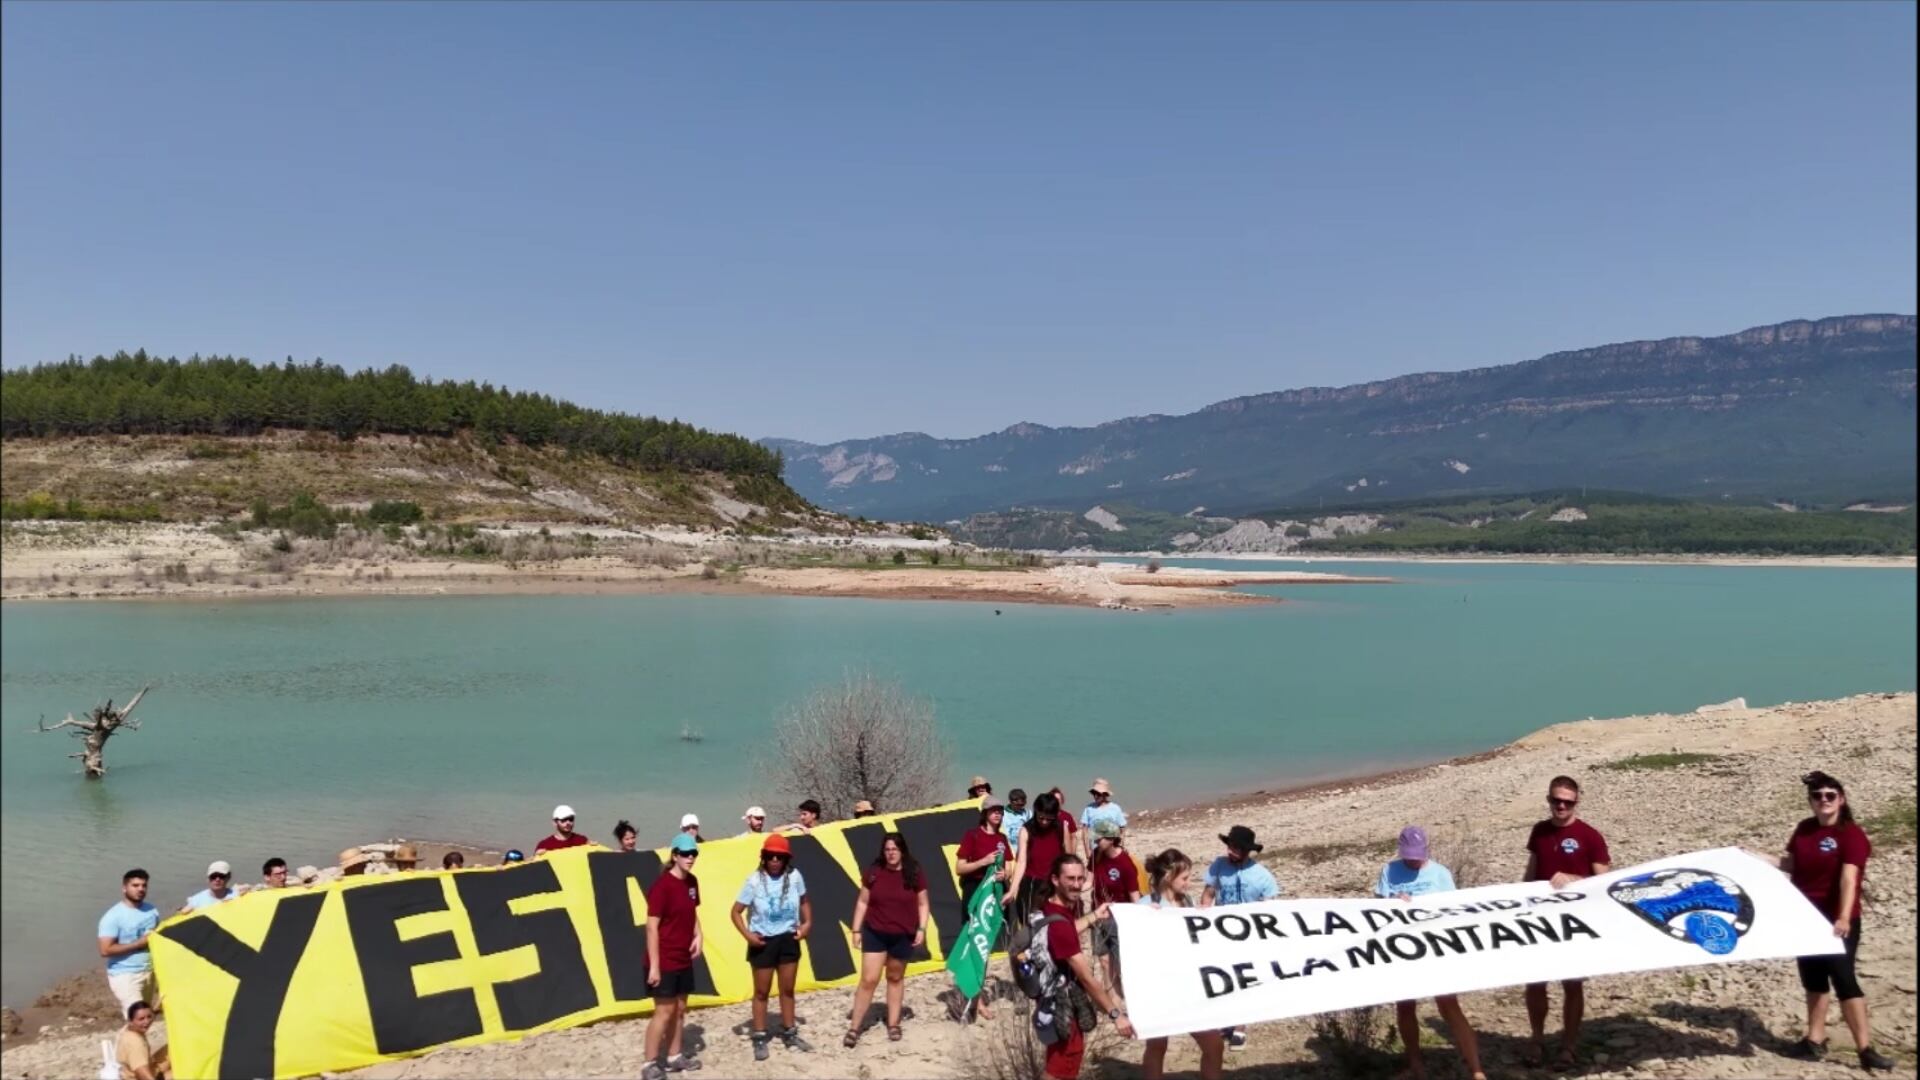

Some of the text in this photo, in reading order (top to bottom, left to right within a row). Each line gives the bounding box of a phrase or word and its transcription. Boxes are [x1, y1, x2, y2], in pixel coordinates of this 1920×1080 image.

[158, 850, 720, 1080] YESA
[1183, 913, 1289, 944] POR
[1291, 911, 1359, 936] LA
[1199, 911, 1601, 999] DE LA MONTAÑA
